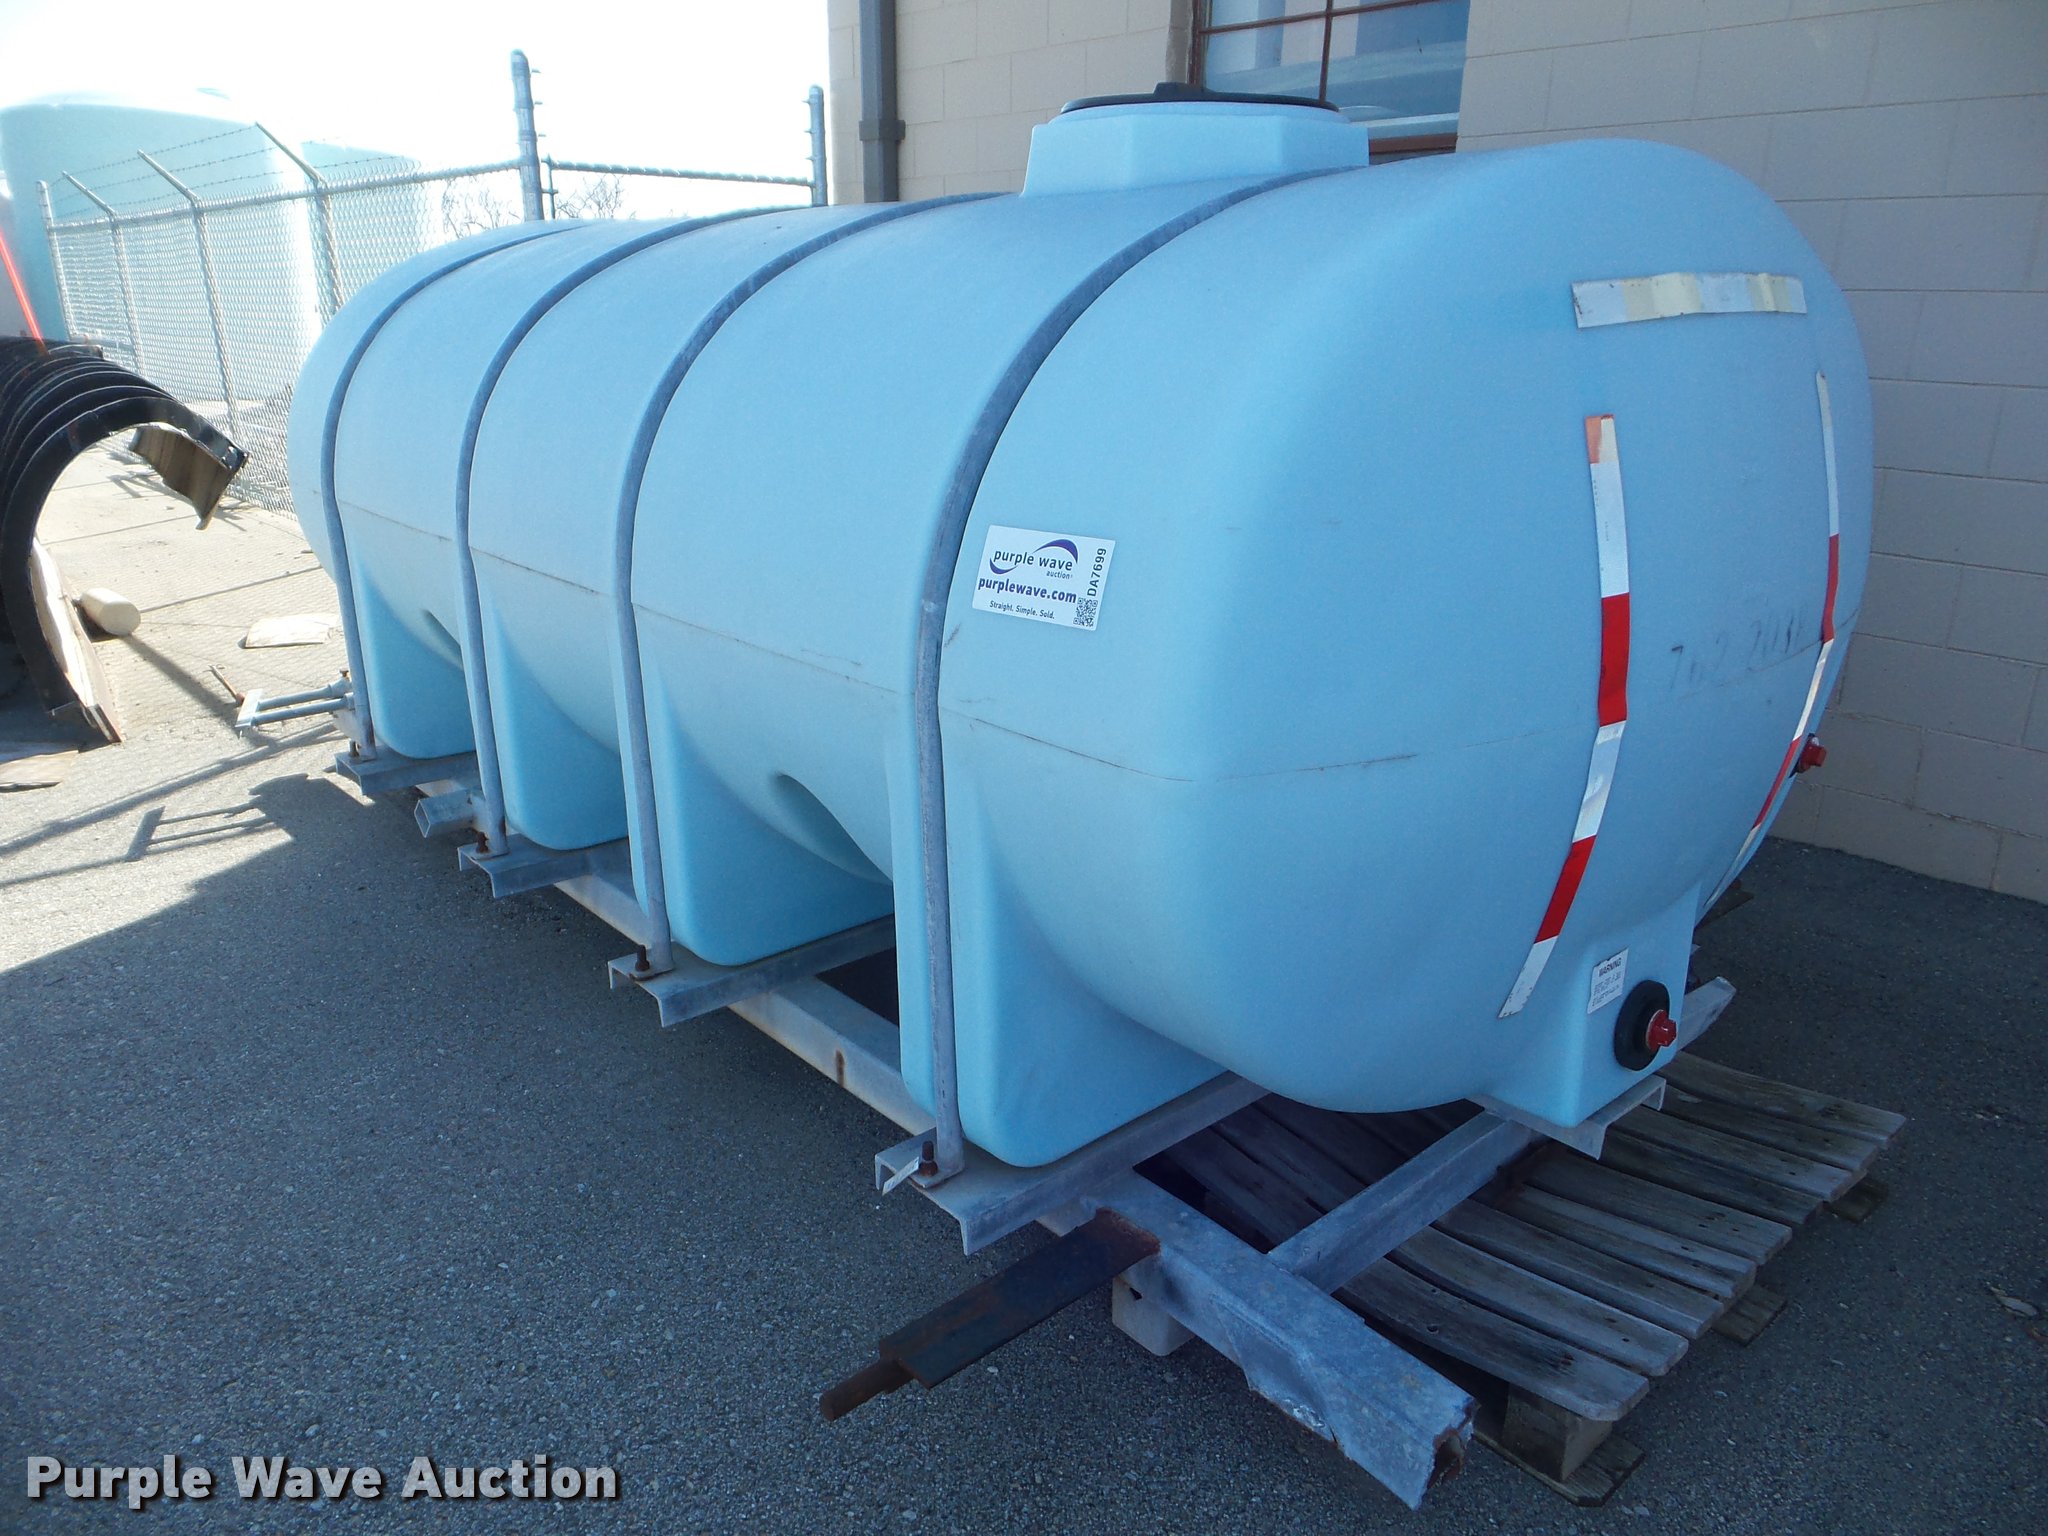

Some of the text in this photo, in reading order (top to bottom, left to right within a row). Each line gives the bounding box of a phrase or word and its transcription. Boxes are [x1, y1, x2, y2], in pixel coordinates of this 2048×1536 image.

[993, 550, 1073, 571] purple wave
[1086, 548, 1107, 597] DA7699
[978, 577, 1077, 604] purplewave.com
[989, 600, 1055, 620] Straight. Simple. Sold.
